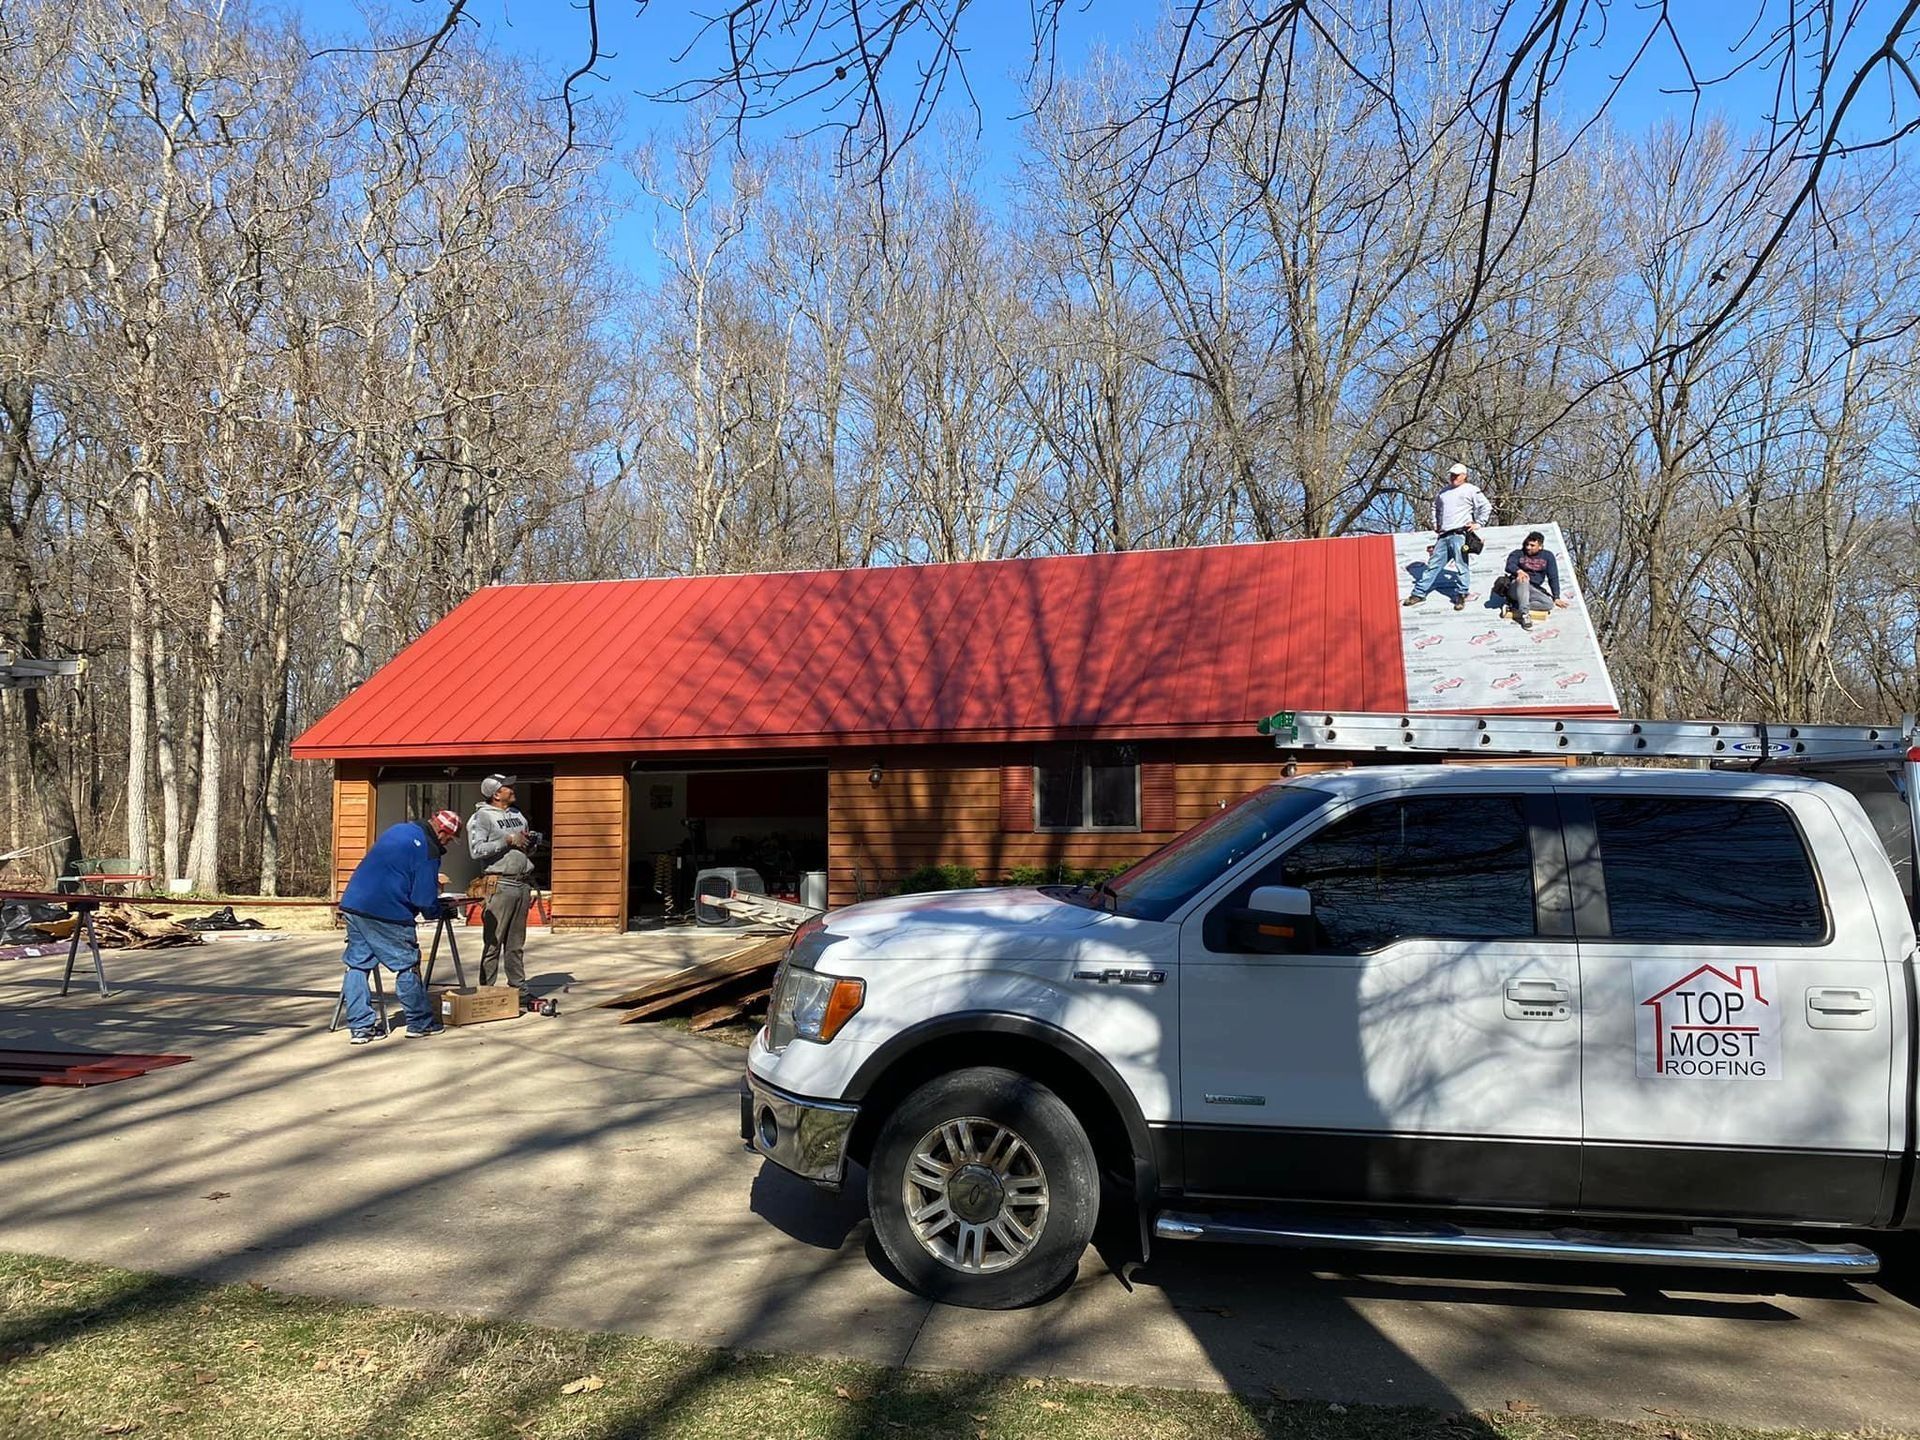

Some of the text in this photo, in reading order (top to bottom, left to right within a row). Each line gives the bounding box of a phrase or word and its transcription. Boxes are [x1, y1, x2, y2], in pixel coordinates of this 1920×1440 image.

[1676, 991, 1744, 1025] TOP
[1670, 1032, 1760, 1057] MOST
[1665, 1060, 1766, 1076] ROOFING
